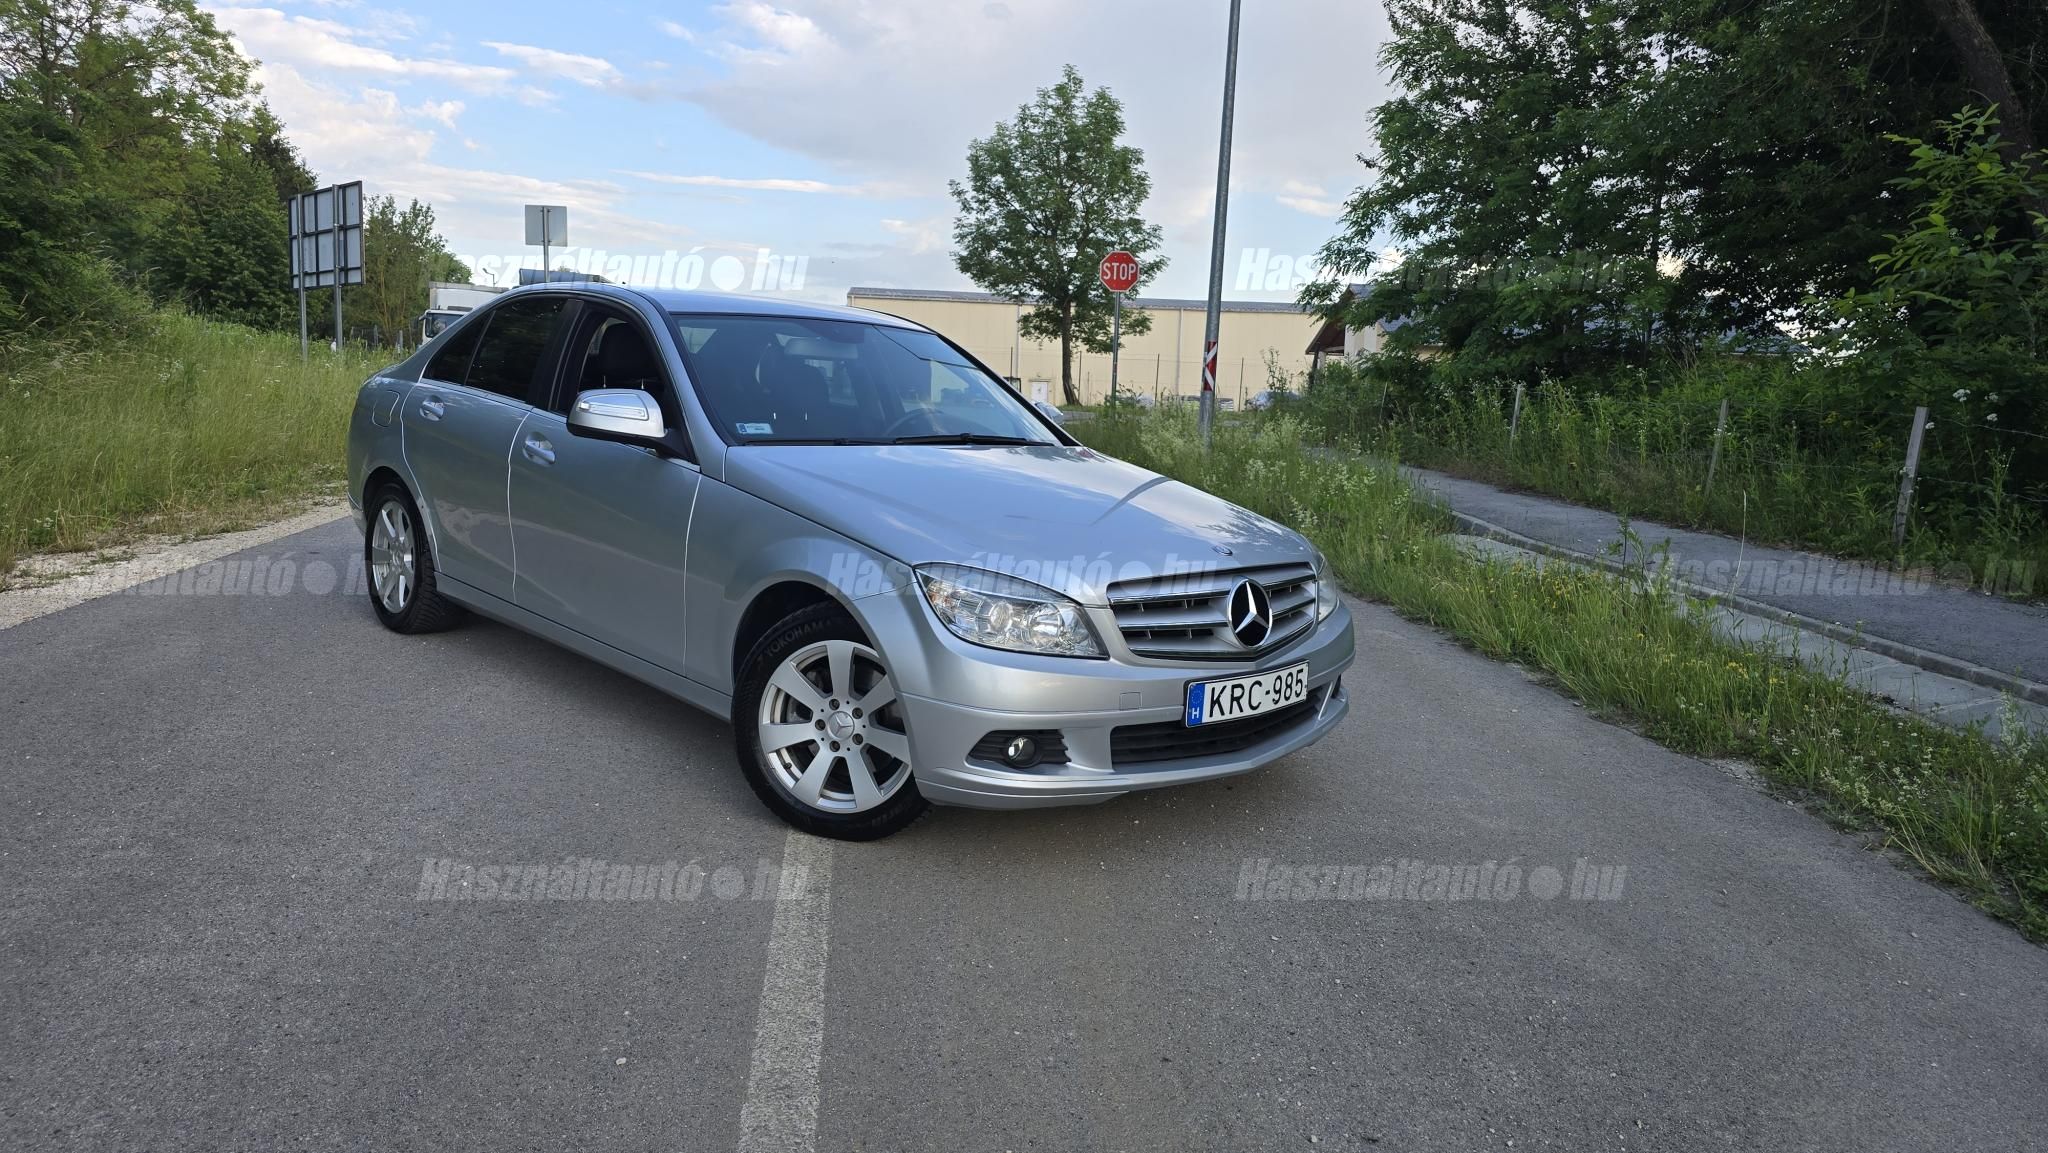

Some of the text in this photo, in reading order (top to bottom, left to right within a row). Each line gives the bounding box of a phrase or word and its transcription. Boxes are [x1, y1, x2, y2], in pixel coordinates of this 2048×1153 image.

[1103, 262, 1137, 281] STOP
[1191, 668, 1304, 720] H KRC-985
